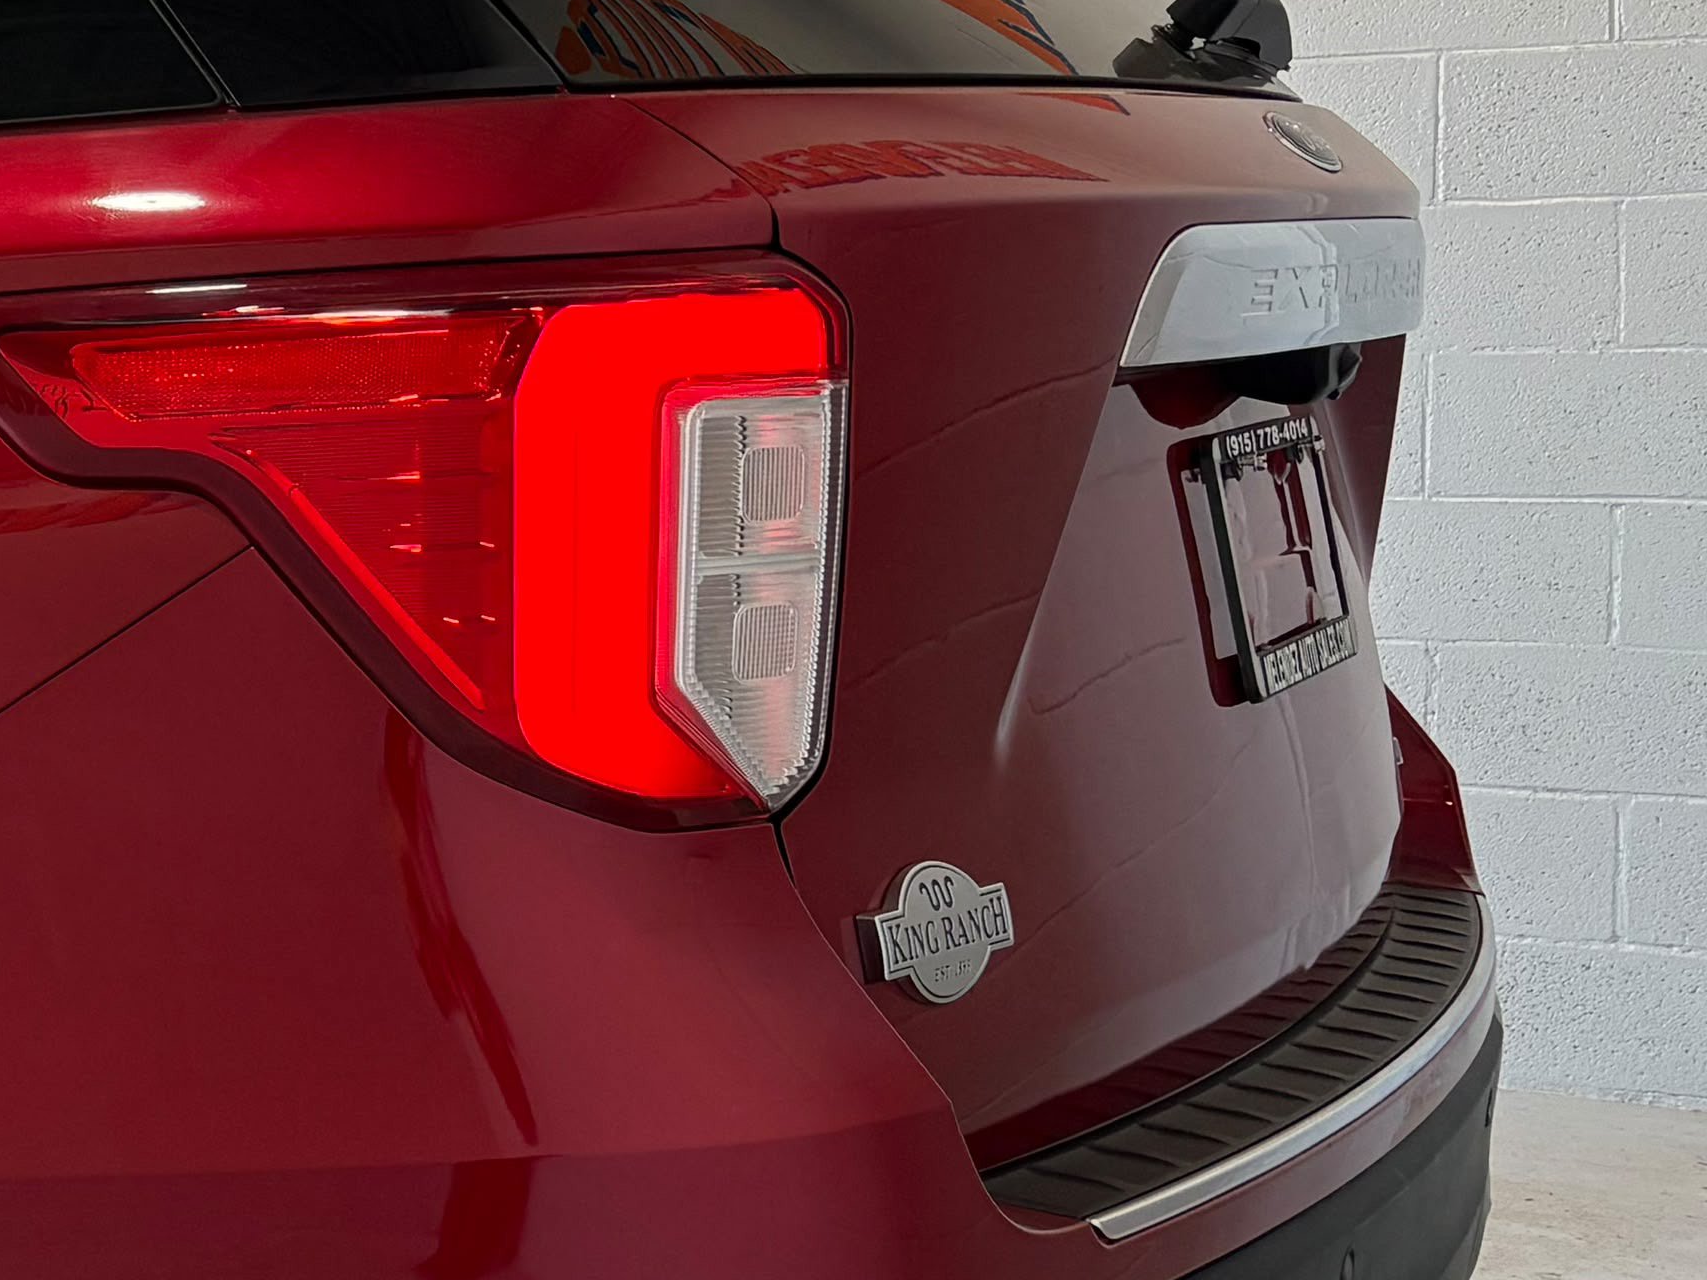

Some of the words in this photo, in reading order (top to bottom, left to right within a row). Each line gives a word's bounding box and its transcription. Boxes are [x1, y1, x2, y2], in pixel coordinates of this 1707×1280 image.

[1240, 258, 1422, 317] EXPL
[1226, 428, 1257, 459] (915)
[1256, 417, 1309, 450] 778-4014
[887, 920, 940, 965] KING
[940, 895, 1009, 951] RANCH
